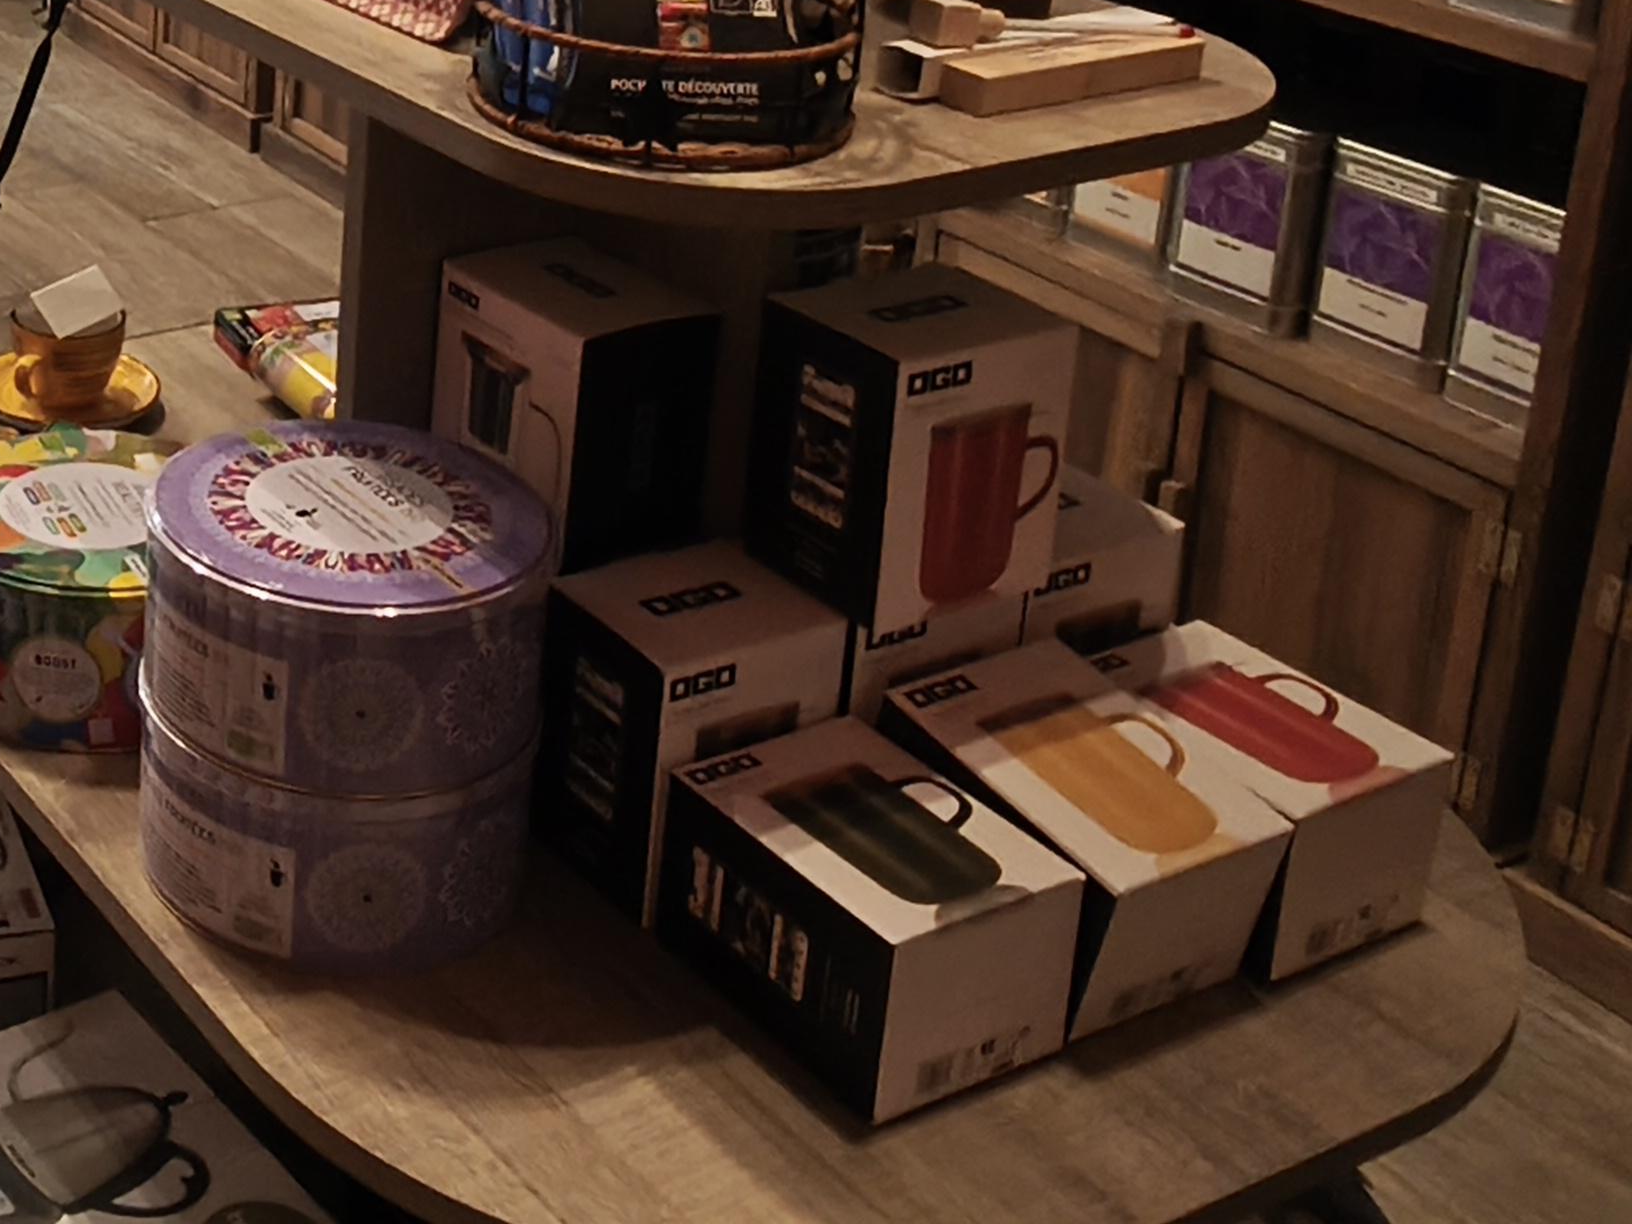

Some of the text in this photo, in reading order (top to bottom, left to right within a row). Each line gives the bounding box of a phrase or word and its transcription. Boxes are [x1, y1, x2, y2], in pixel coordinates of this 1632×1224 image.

[678, 78, 759, 95] DÉCOUVERTE
[907, 360, 973, 397] OGO
[669, 663, 737, 703] OGO
